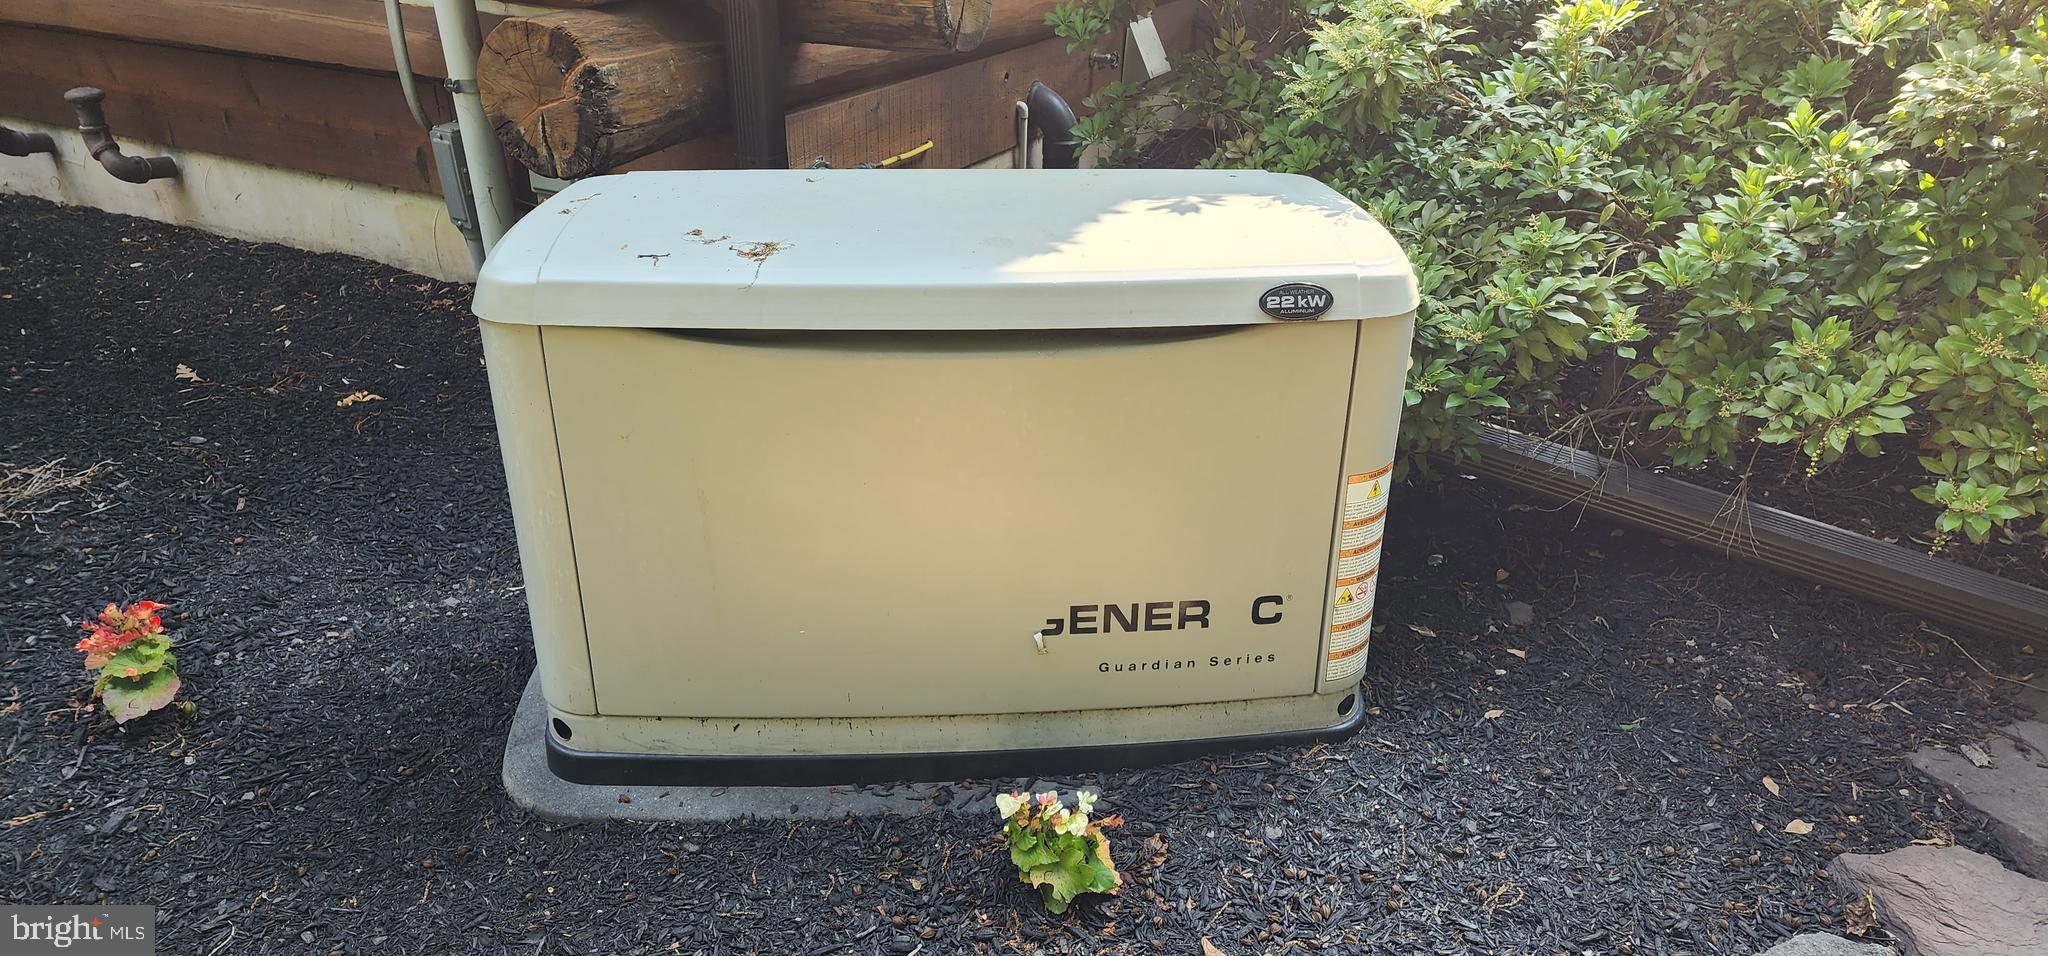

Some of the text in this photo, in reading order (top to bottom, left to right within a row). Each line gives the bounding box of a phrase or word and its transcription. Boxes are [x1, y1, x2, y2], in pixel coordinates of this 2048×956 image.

[1266, 294, 1326, 309] 22 kW
[1099, 653, 1276, 673] Guardian Series
